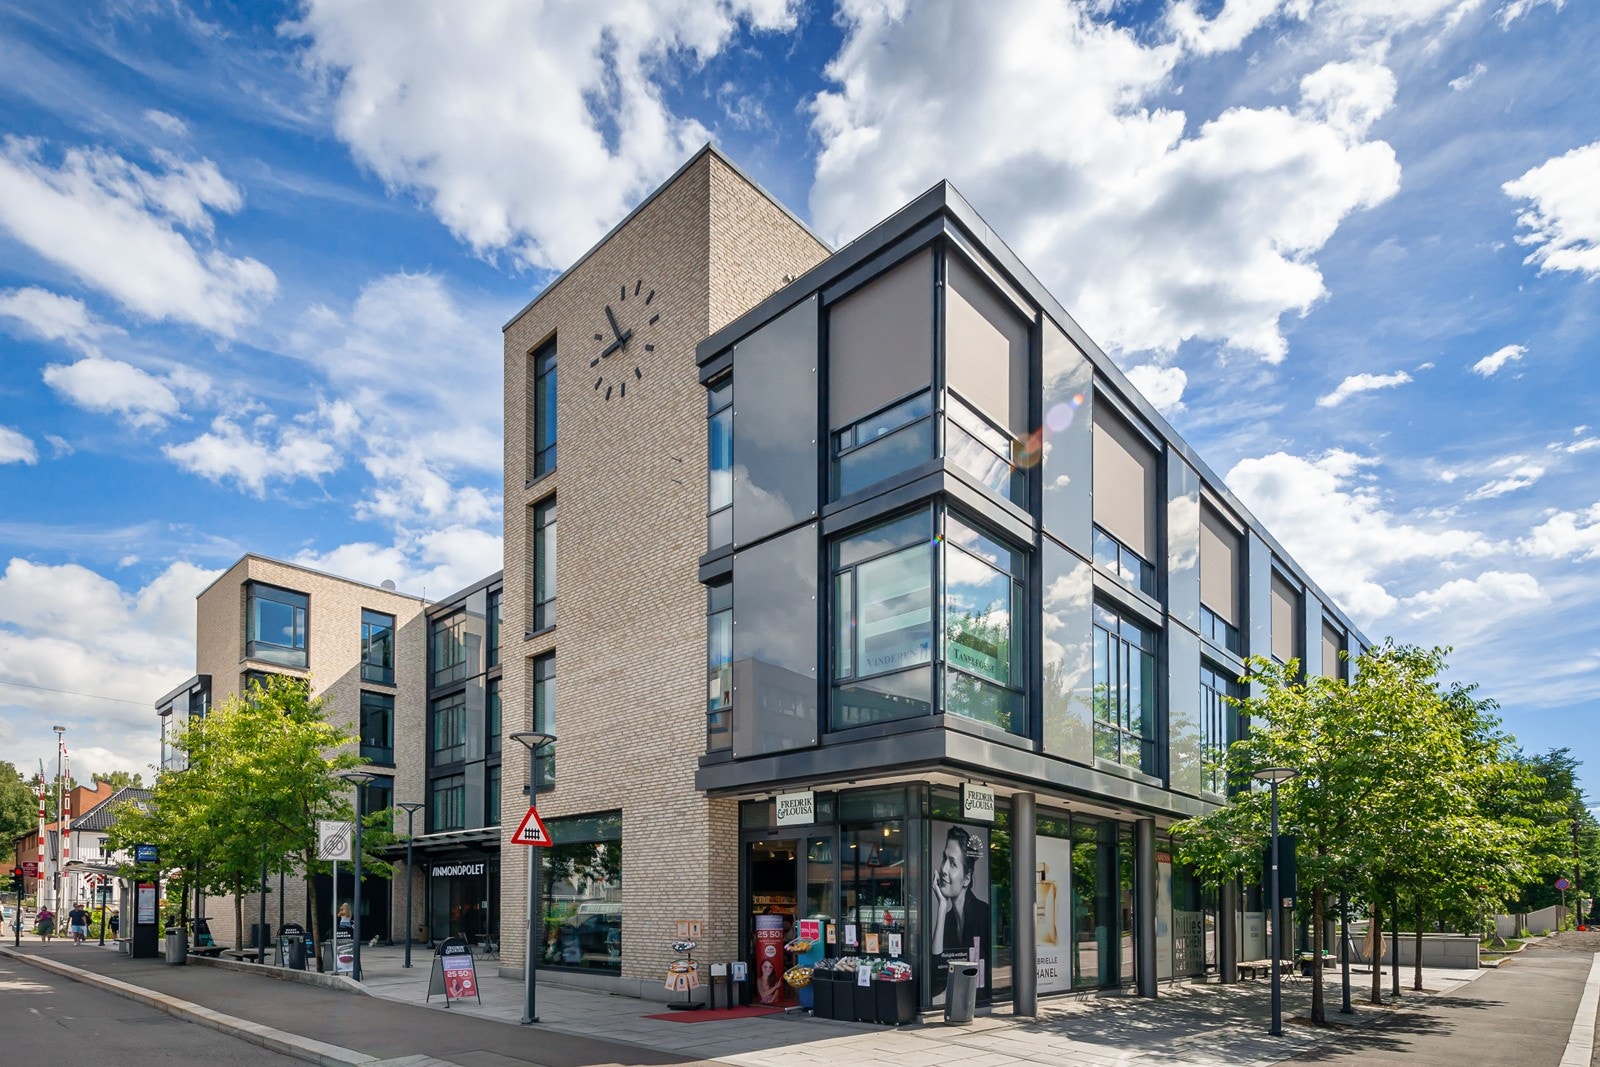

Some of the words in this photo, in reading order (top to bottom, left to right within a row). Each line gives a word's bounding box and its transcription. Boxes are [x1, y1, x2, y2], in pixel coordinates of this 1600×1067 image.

[968, 790, 994, 802] FREDRIK
[780, 797, 812, 808] FREDRIK
[1036, 968, 1058, 979] HANEL
